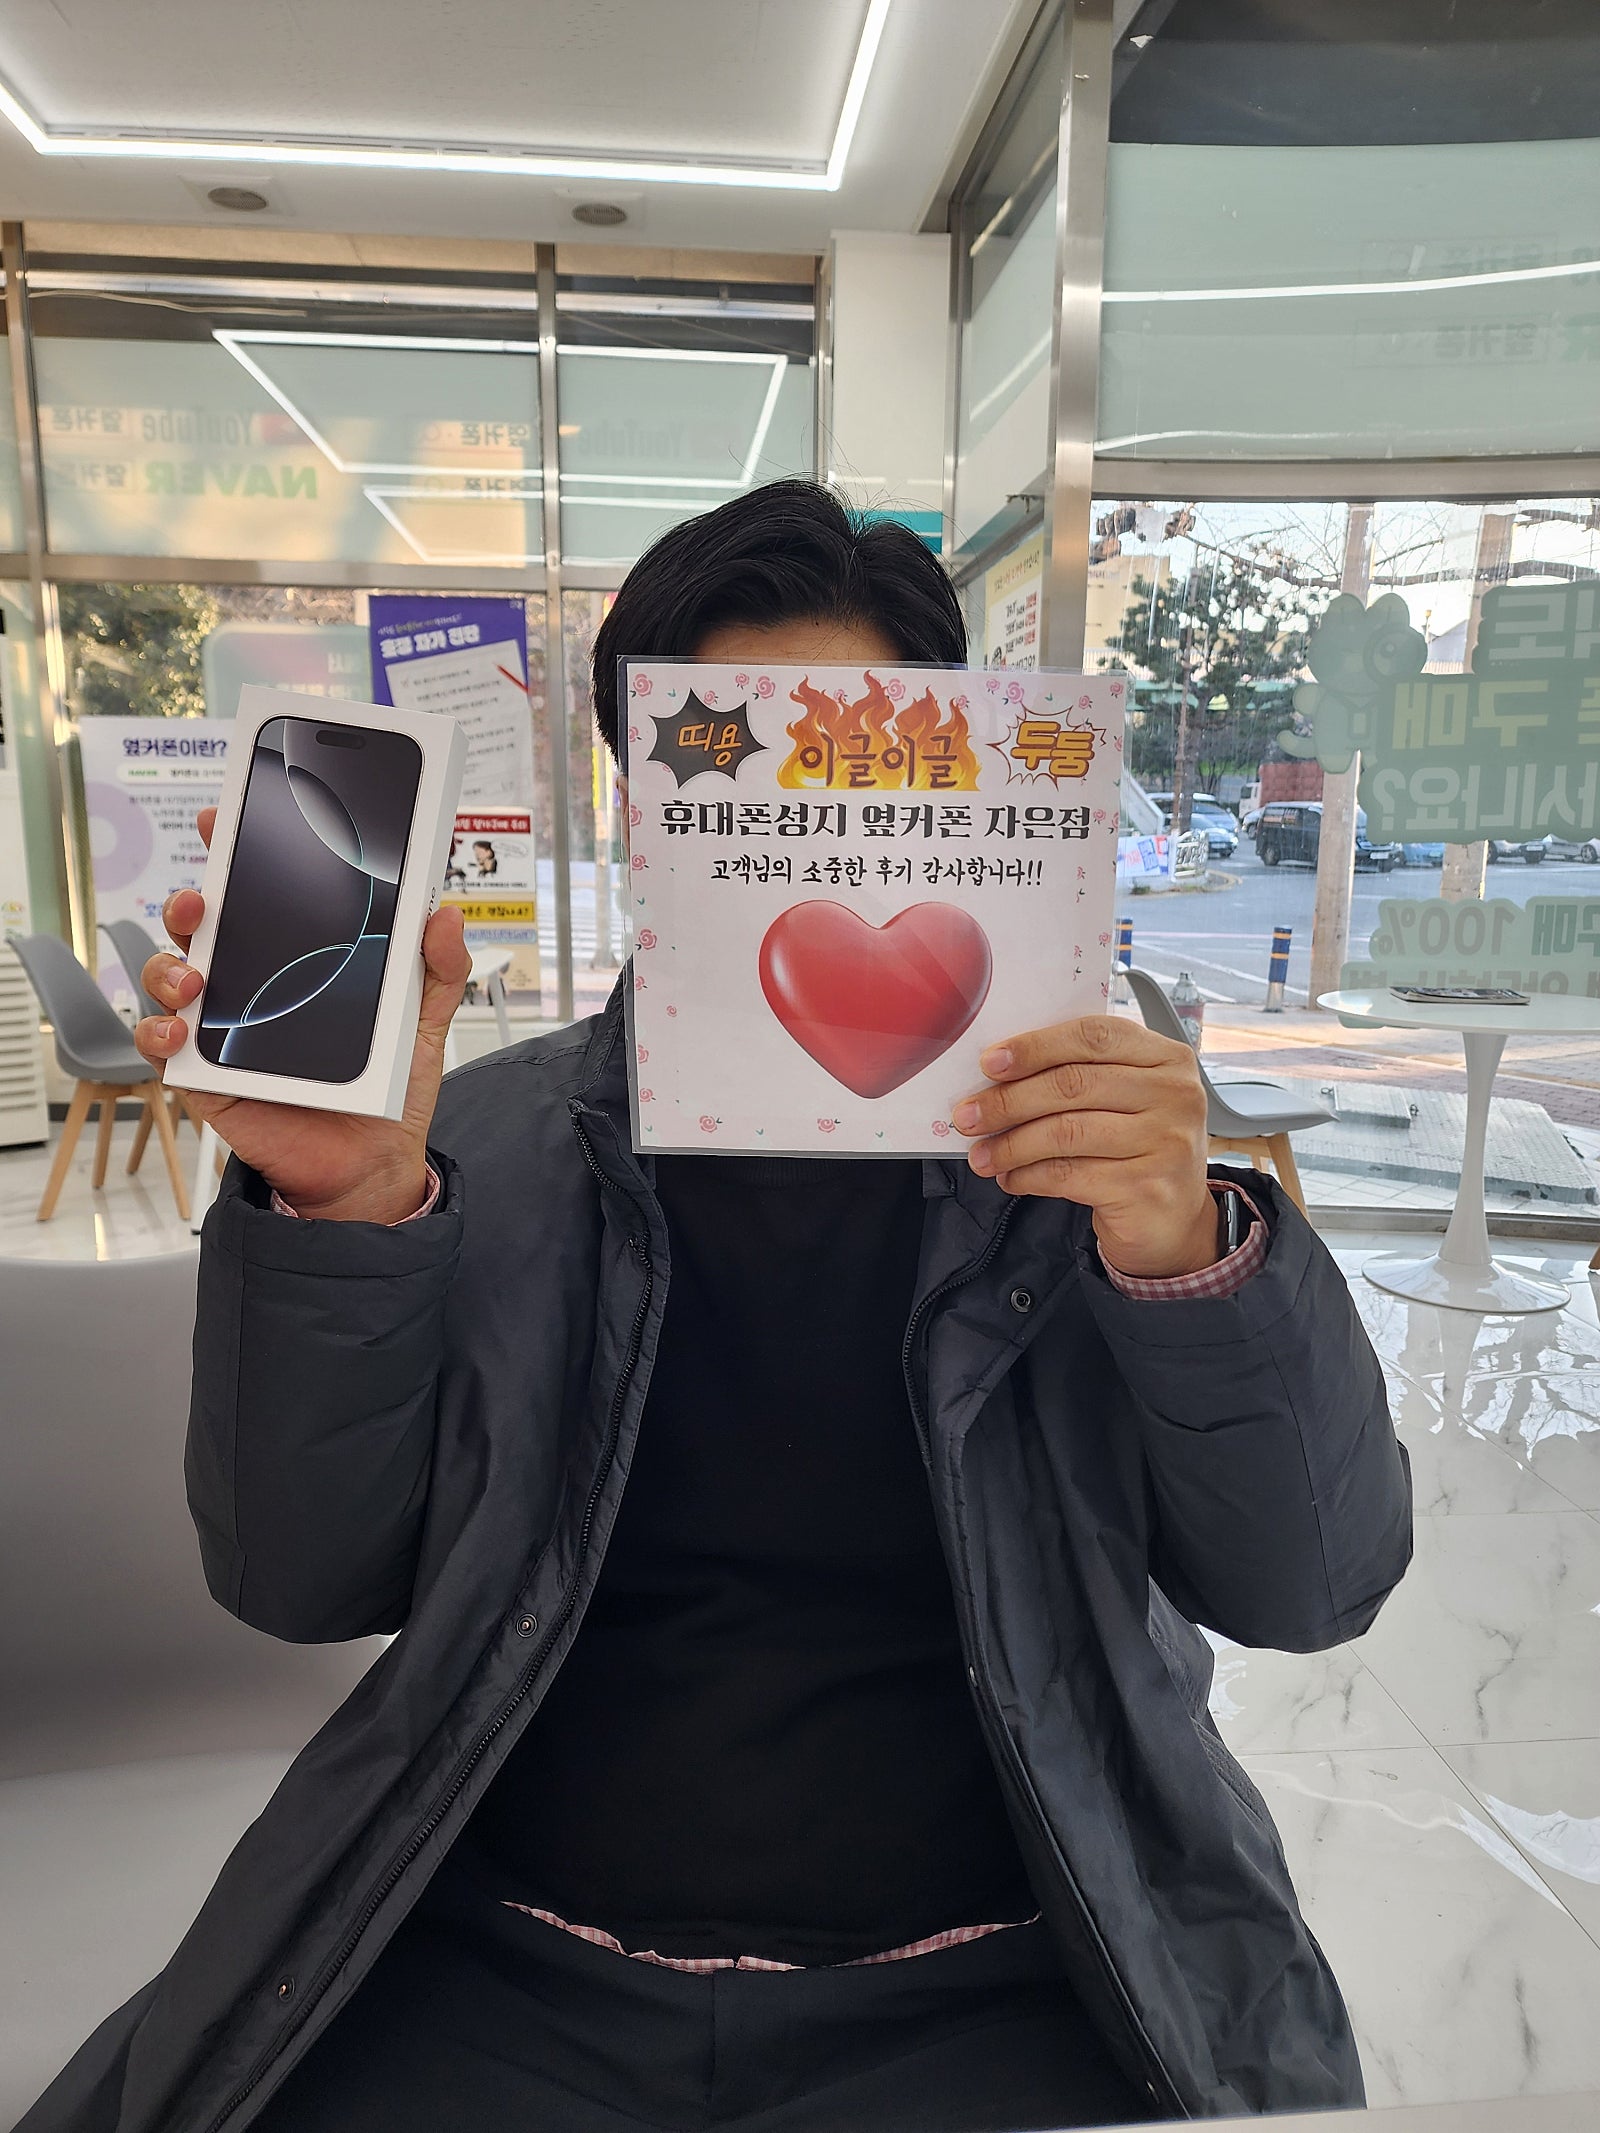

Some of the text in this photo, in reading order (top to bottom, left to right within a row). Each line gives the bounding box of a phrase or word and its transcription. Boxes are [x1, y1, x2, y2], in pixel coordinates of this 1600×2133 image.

[123, 737, 227, 757] 옆커폰이란?
[677, 721, 742, 768] 띠용
[798, 733, 958, 790] 이글이글
[1010, 720, 1095, 779] 두둥
[660, 799, 1092, 841] 휴대폰성지 옆커폰 자은점
[710, 854, 1043, 888] 고객님의 소중한 후기 감사합니다!!
